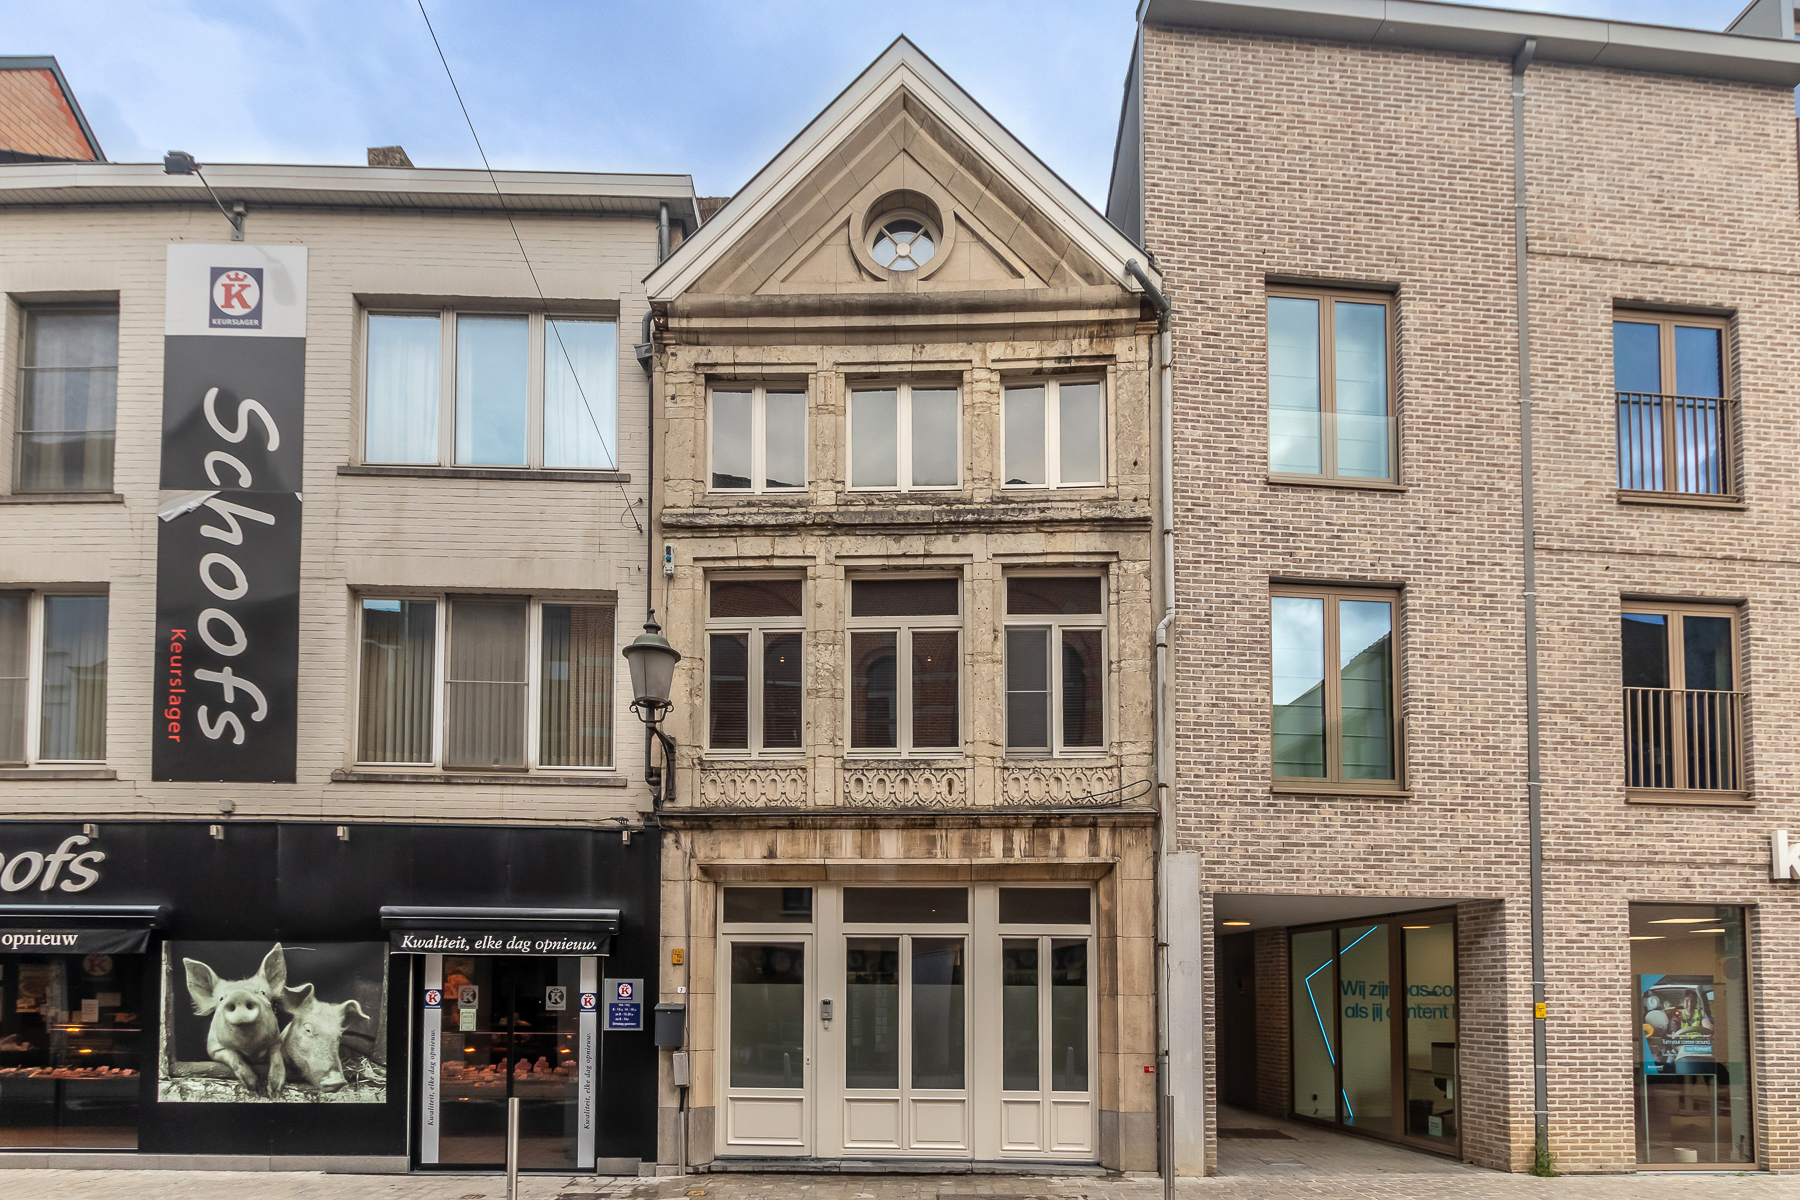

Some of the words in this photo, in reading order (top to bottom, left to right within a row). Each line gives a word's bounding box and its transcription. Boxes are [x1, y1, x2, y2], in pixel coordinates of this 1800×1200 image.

[220, 283, 252, 309] K
[211, 318, 260, 326] KEURSLAGER
[194, 387, 280, 745] Schoofs
[165, 628, 187, 743] Keurslager
[0, 835, 106, 892] ofs
[1, 929, 79, 949] opnieuw
[401, 934, 470, 951] Kwaliteit,
[474, 935, 503, 950] elke
[506, 936, 531, 953] dag
[535, 937, 598, 953] opnieuw.
[427, 993, 439, 1004] K
[550, 991, 562, 1004] K
[1341, 979, 1366, 1000] Wij
[1407, 984, 1429, 997] as
[1432, 984, 1455, 997] co
[583, 997, 594, 1007] K
[1345, 1002, 1369, 1019] als
[427, 1061, 437, 1075] dag
[584, 1065, 592, 1079] dag
[427, 1076, 435, 1091] elke
[583, 1080, 591, 1094] elke
[427, 1092, 436, 1126] Kwaliteit,
[583, 1095, 591, 1130] Kwaliteit,
